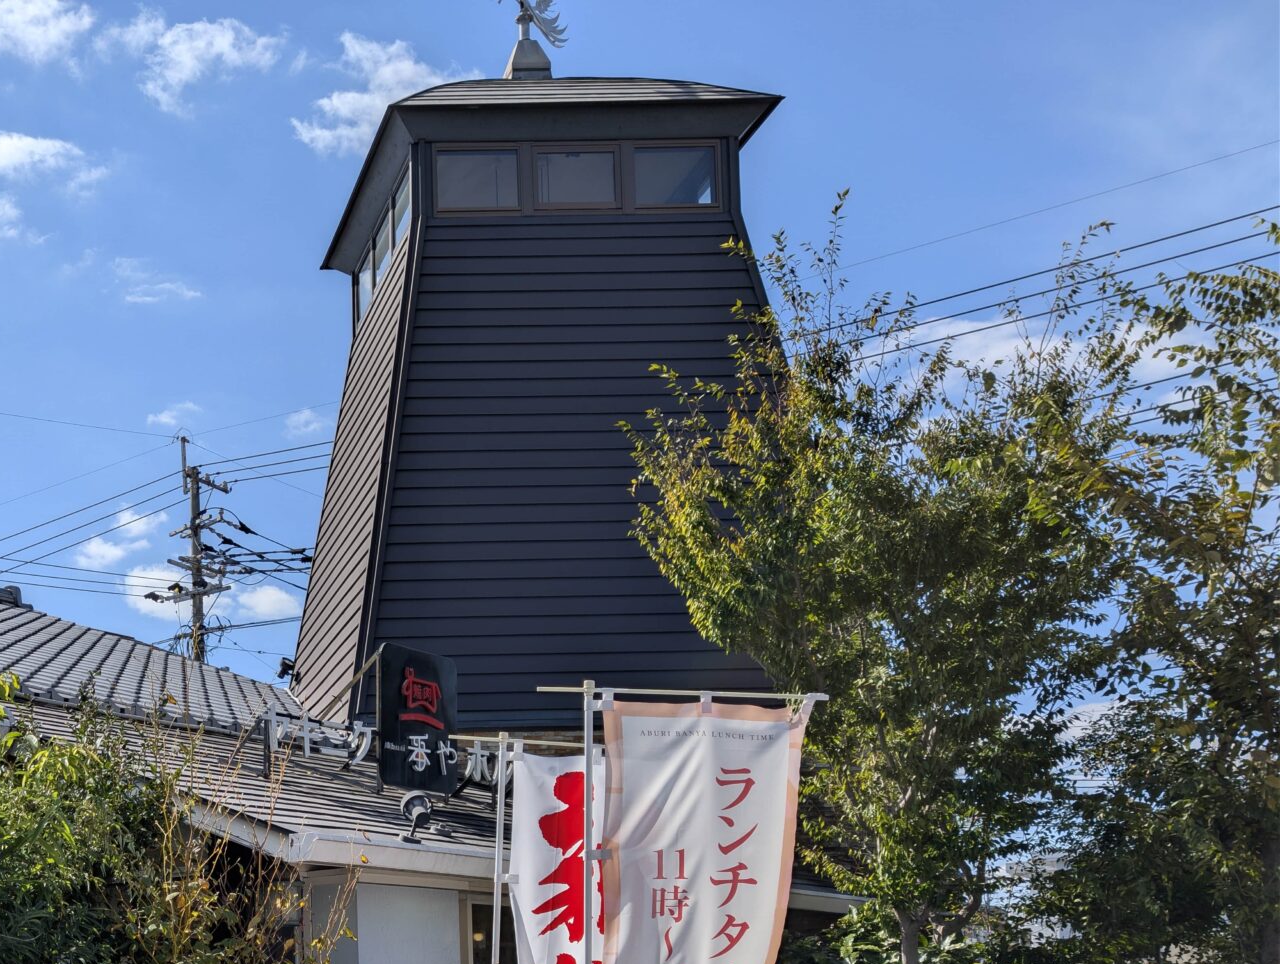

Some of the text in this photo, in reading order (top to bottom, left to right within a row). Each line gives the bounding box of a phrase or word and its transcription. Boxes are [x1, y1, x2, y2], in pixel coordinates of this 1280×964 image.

[640, 729, 776, 741] ABURI BANYA LUNCH TIME
